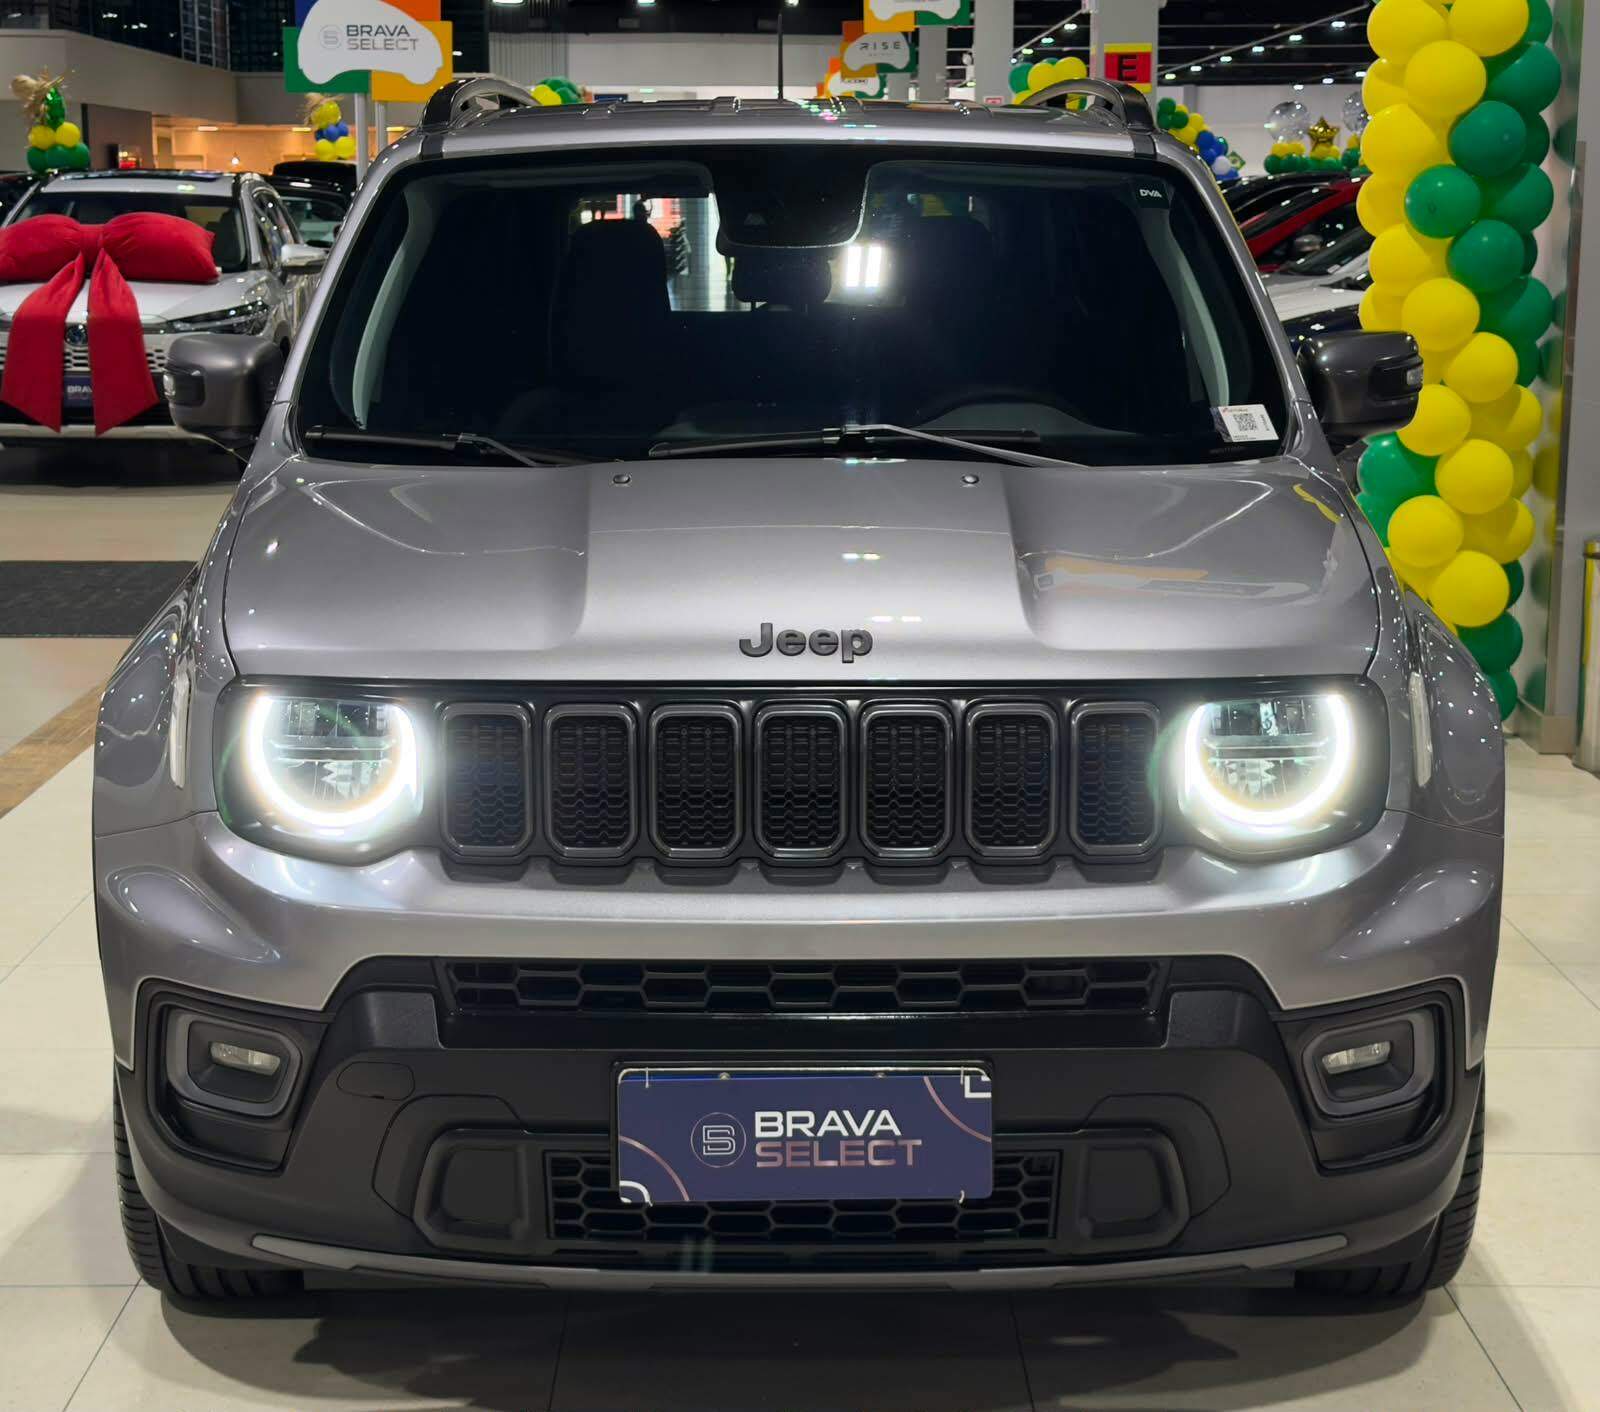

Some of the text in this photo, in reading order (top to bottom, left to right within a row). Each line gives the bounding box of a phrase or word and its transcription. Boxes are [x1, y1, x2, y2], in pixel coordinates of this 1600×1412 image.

[346, 25, 410, 37] BRAVA
[346, 38, 419, 51] SELECT
[859, 41, 901, 51] RISE
[1118, 54, 1137, 82] E
[739, 622, 873, 664] Jeep
[754, 1109, 902, 1138] BRAVA
[754, 1139, 922, 1168] SELECT
